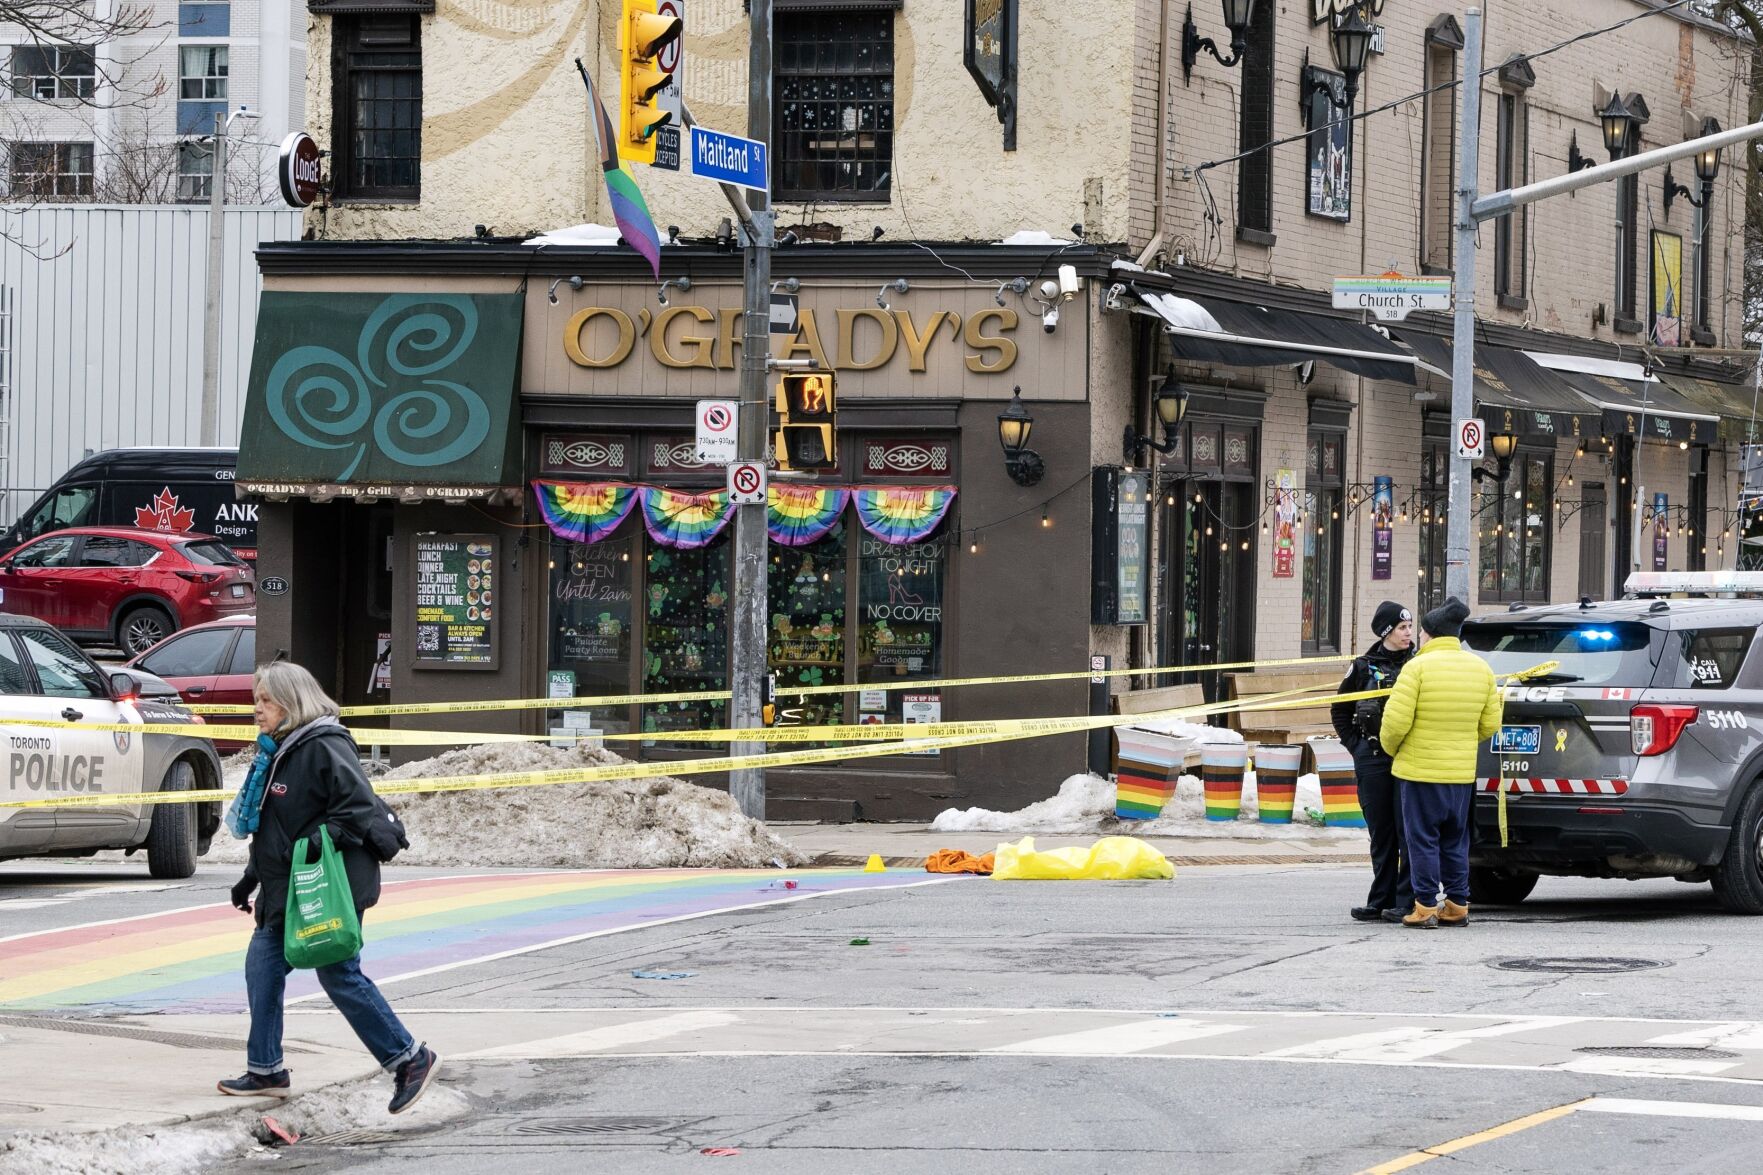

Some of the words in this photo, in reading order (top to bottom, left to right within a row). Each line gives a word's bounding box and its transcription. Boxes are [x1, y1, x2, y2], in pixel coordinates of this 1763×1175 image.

[656, 132, 677, 148] ICYCLES
[656, 150, 678, 166] XCEPTED
[698, 133, 749, 173] Maitland
[754, 146, 761, 162] St
[296, 153, 319, 183] LODGE
[1359, 294, 1404, 307] Church
[1411, 295, 1426, 308] St.
[215, 471, 235, 480] GEN
[247, 484, 306, 494] O'GRADY'S
[340, 486, 359, 496] Tap
[367, 485, 391, 496] Grill
[427, 487, 484, 496] O'GRADY'S
[215, 525, 247, 536] Design
[418, 542, 458, 551] BREAKFAST
[569, 544, 623, 562] Kitchen
[863, 541, 900, 556] DRAG
[418, 551, 441, 562] LUNCH
[418, 562, 444, 572] DINNER
[571, 564, 615, 578] OPEN
[878, 558, 936, 574] TONIGHT
[417, 574, 434, 583] LATE
[436, 574, 458, 583] NIGHT
[266, 582, 282, 590] 518
[417, 584, 456, 594] COCKTAILS
[557, 578, 597, 601] Until
[600, 586, 631, 601] 2am
[417, 595, 435, 605] BEER
[445, 596, 463, 605] WINE
[868, 604, 890, 619] NO
[893, 606, 941, 622] COVER
[1381, 625, 1393, 637] POLICE
[565, 645, 591, 654] Party
[592, 646, 617, 654] Room
[1706, 710, 1747, 729] 5110
[10, 737, 50, 750] TORONTO
[1522, 733, 1538, 746] 808
[10, 753, 104, 792] POLICE
[1502, 760, 1529, 772] 5110
